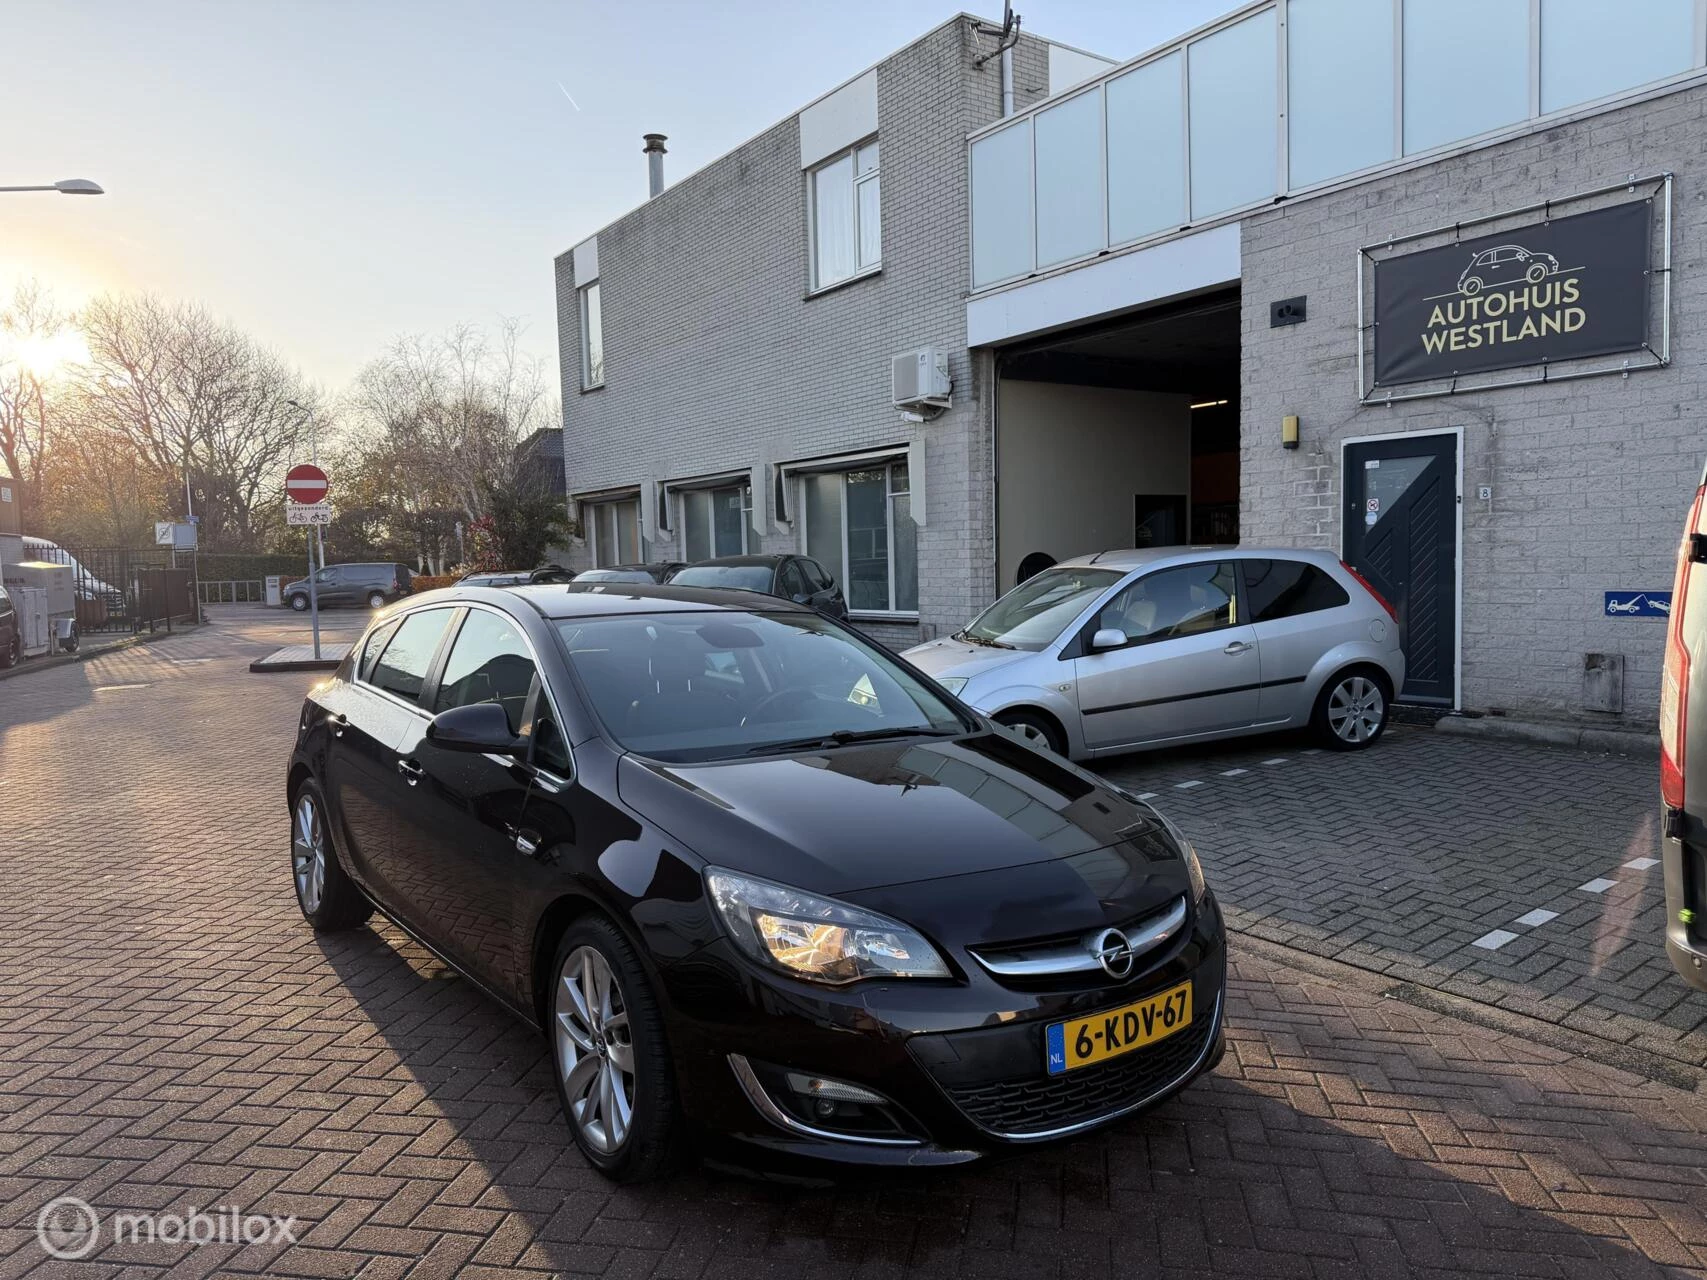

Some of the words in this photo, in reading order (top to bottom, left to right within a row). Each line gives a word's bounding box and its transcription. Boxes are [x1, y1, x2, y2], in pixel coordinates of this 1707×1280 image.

[1427, 278, 1580, 328] AUTOHUIS
[1421, 307, 1586, 355] WESTLAND
[1482, 488, 1489, 498] 8
[1075, 989, 1187, 1059] 6-KDV-67
[1050, 1053, 1063, 1065] NL
